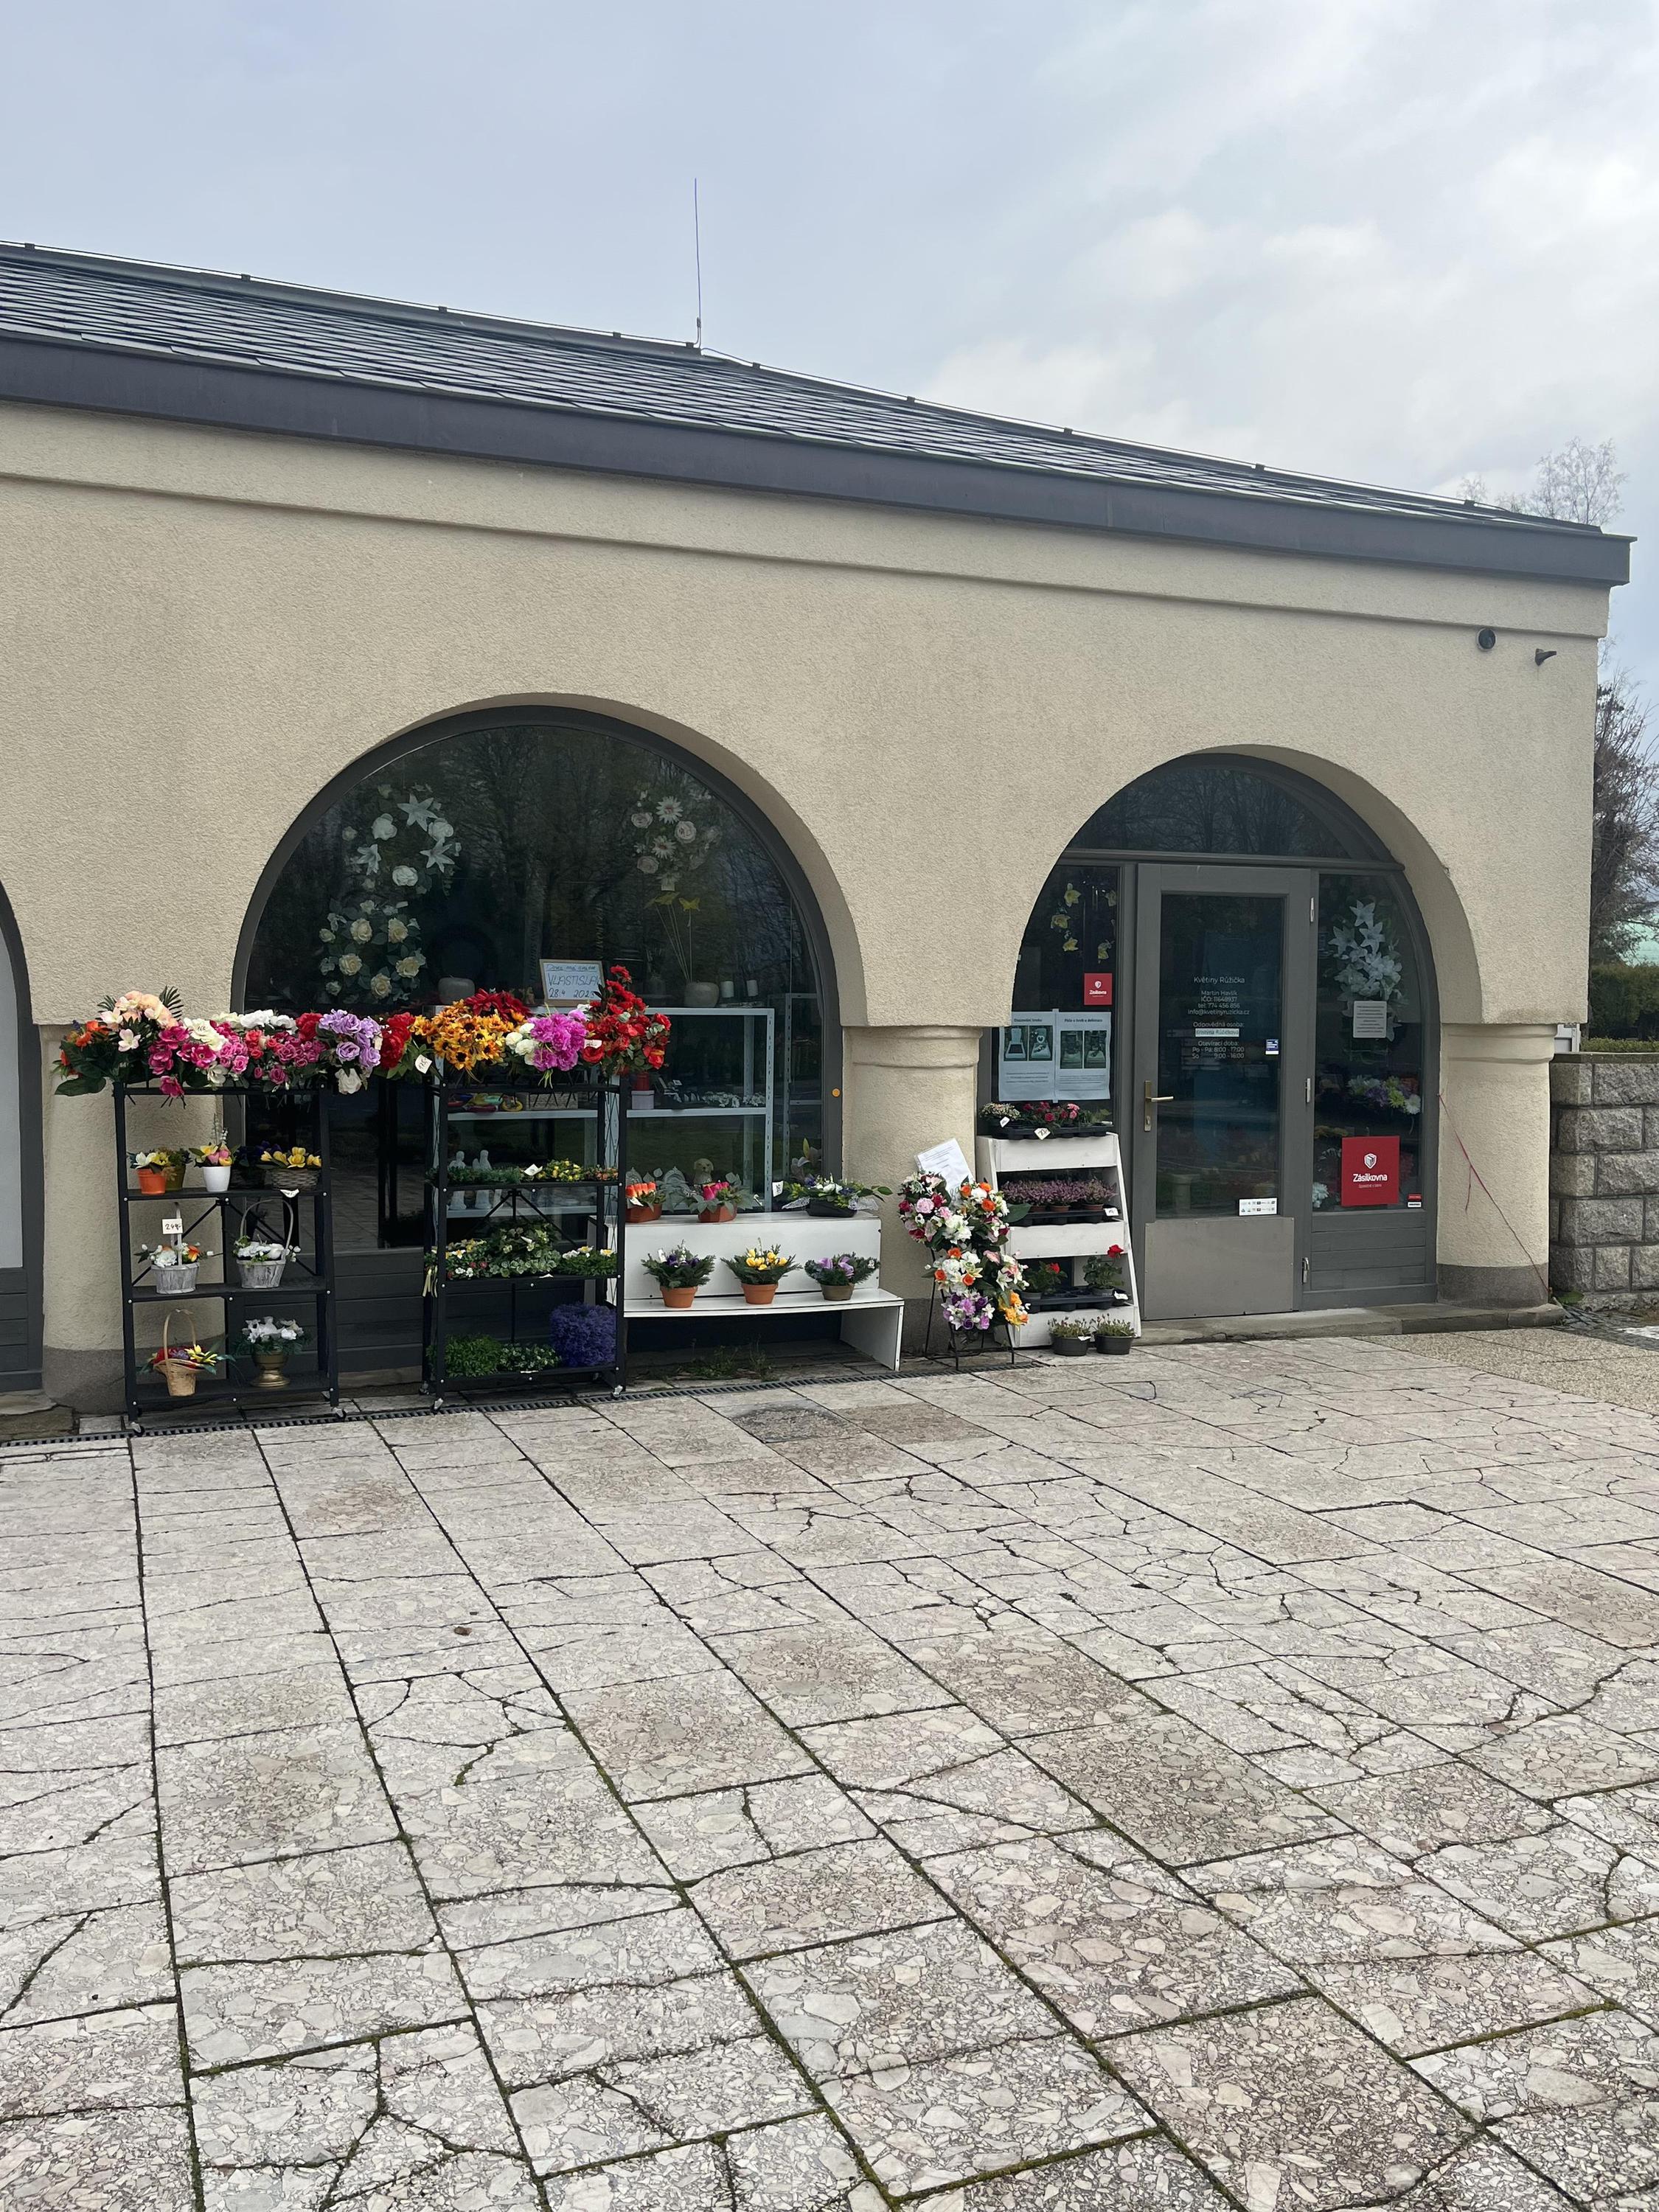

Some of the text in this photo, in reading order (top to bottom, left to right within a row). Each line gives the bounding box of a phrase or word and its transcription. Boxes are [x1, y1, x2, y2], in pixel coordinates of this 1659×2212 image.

[1194, 975, 1245, 985] Květiny Růžička
[1352, 1173, 1388, 1183] Zásilkovna
